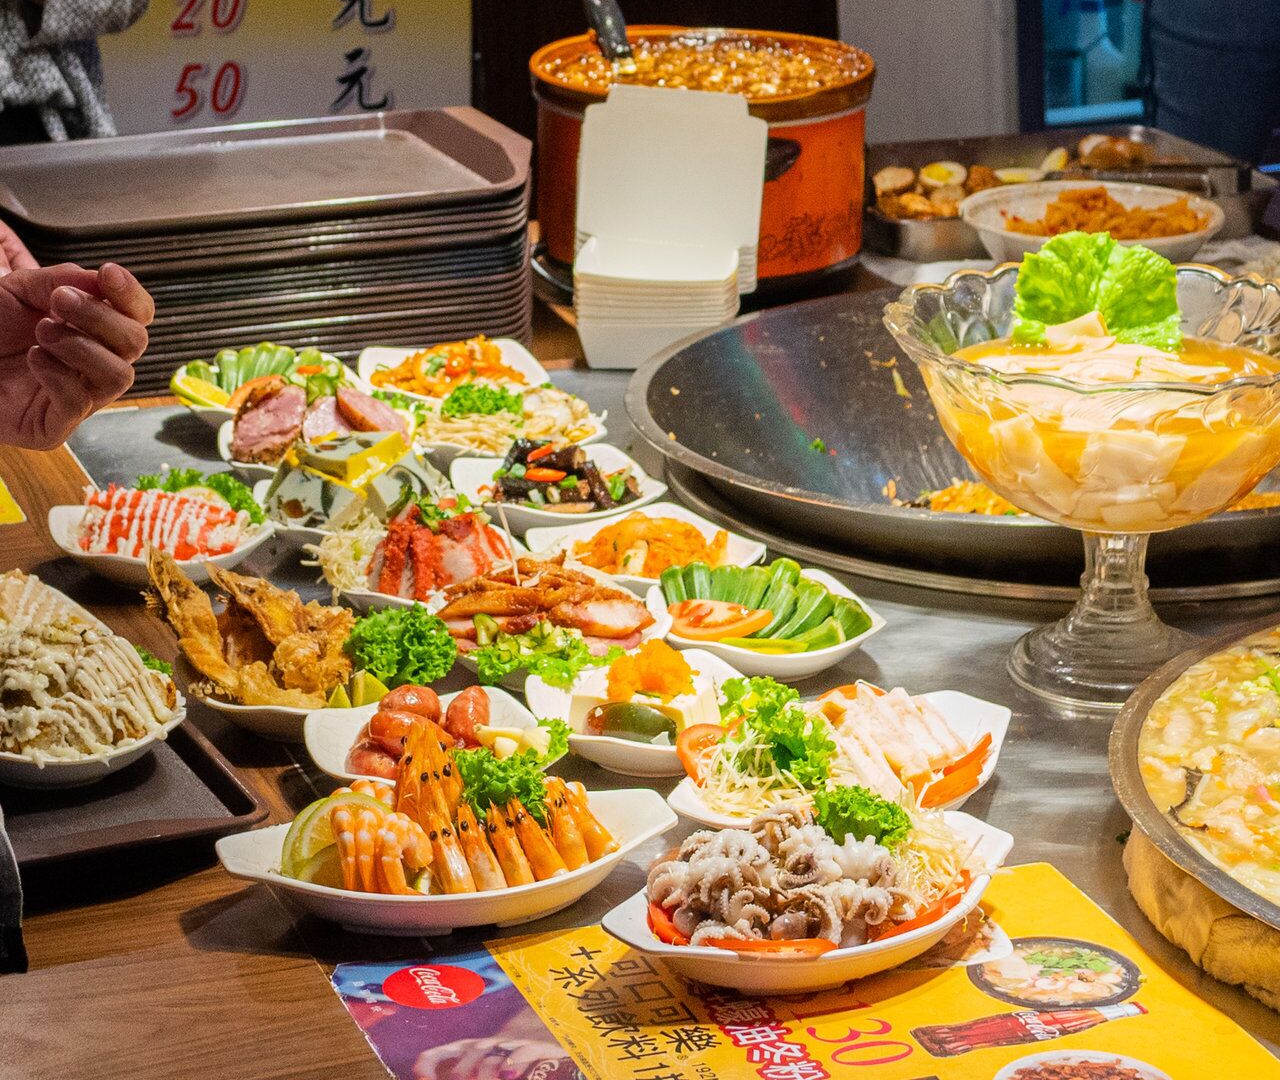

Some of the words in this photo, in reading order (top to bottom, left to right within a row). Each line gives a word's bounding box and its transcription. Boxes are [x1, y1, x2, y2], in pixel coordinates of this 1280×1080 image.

[172, 62, 241, 116] 50
[332, 49, 388, 110] 元
[608, 953, 722, 1054] 可口可樂
[786, 983, 914, 1067] 130
